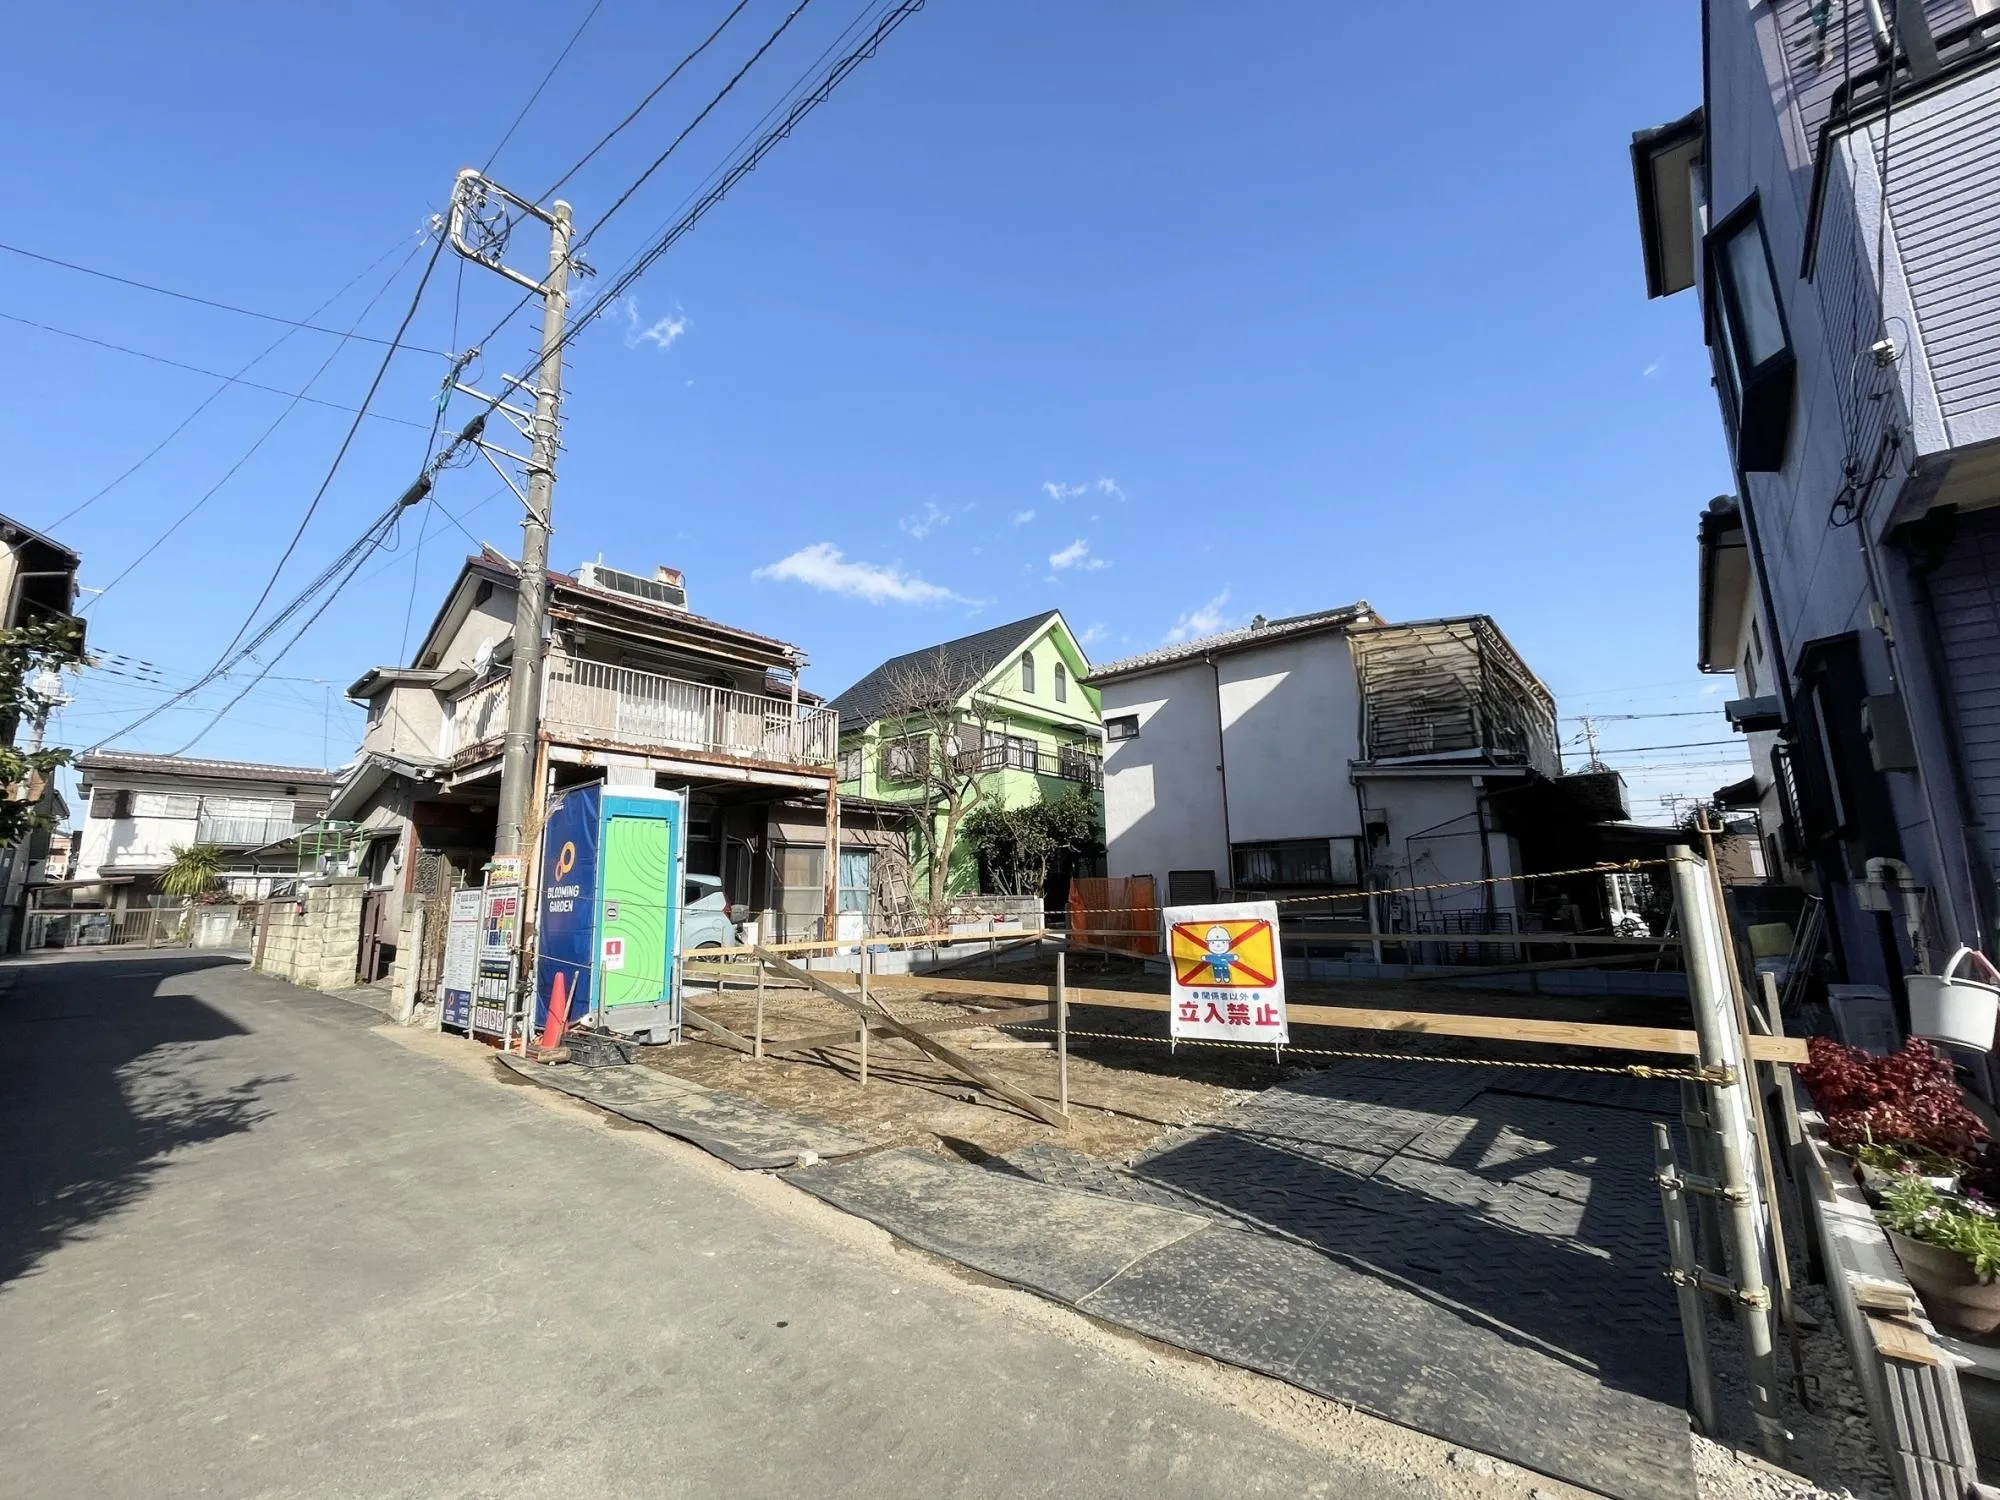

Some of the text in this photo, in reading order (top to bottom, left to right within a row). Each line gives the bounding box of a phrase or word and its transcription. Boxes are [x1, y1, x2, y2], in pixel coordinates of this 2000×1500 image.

[547, 885, 580, 899] BLOOMING
[549, 900, 574, 912] GARDEN
[1201, 991, 1250, 1001] 関係者以外
[1178, 1001, 1281, 1026] 立入禁止
